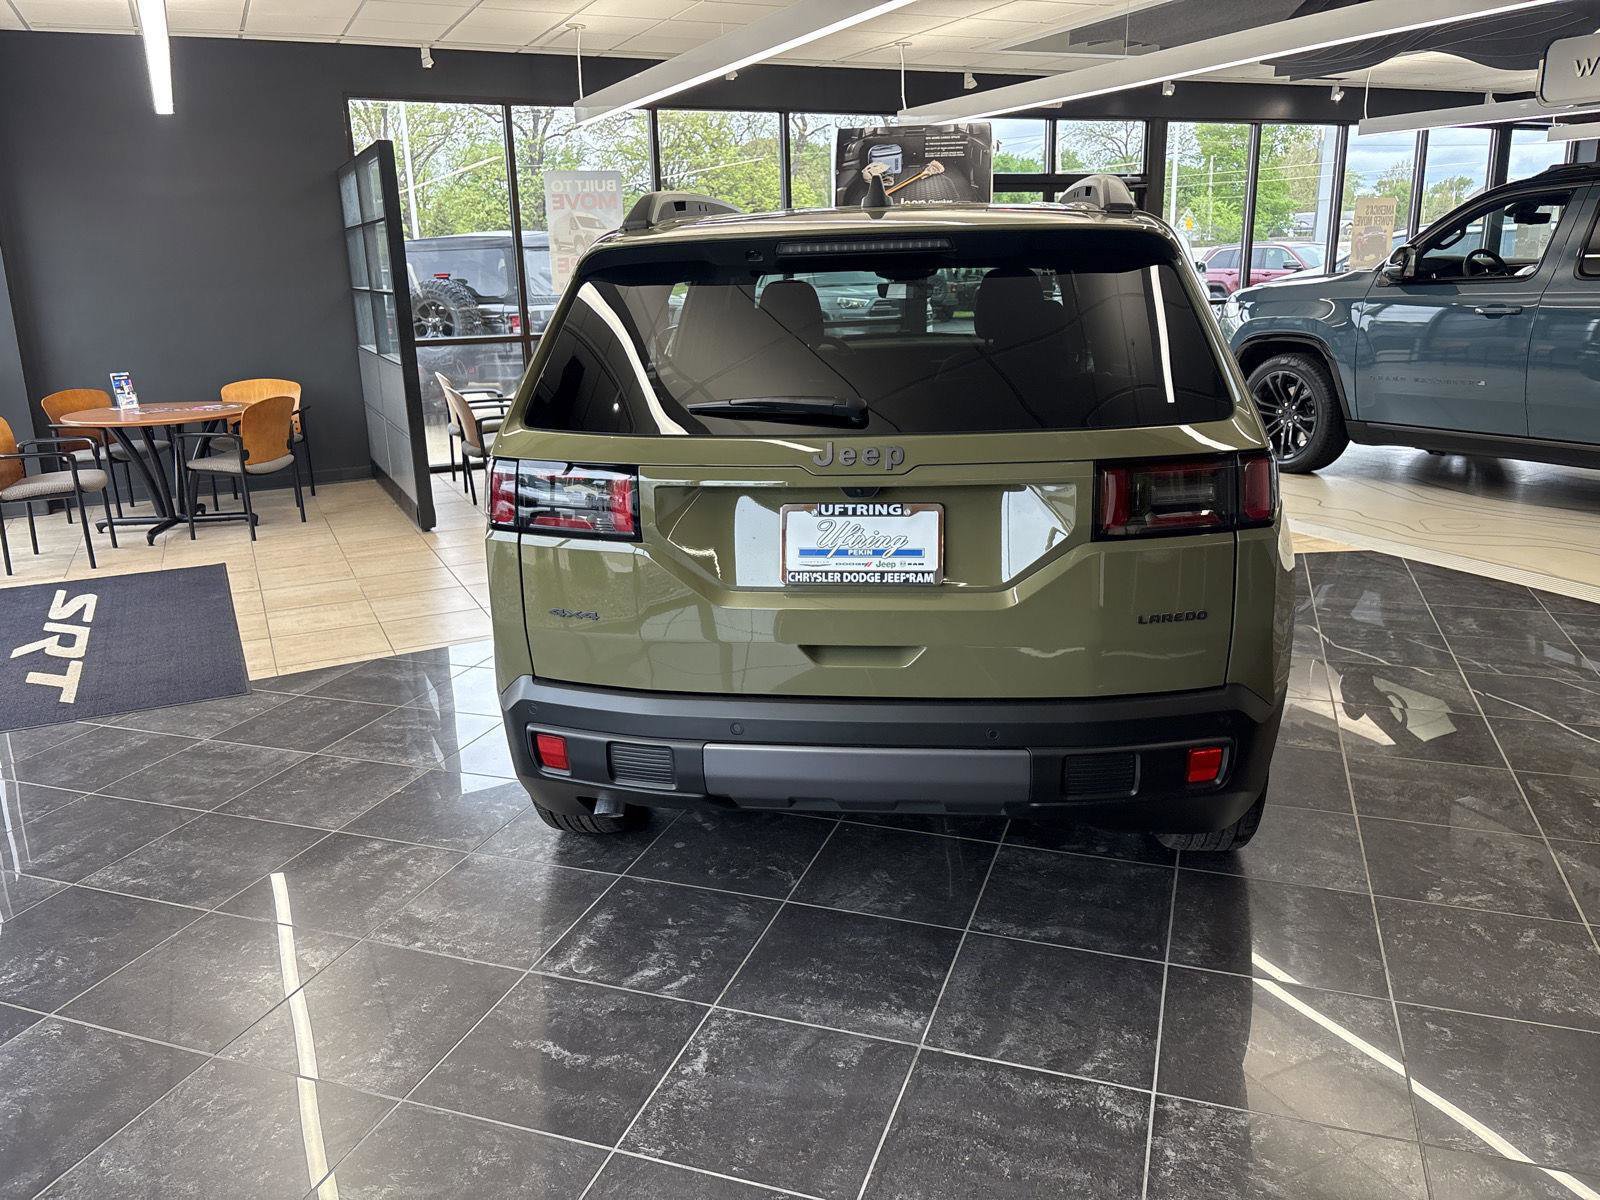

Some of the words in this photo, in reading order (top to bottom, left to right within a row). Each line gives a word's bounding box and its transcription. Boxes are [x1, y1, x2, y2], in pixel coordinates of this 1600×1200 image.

[813, 441, 905, 471] Jeep
[820, 503, 903, 516] UFTRING
[816, 518, 909, 560] Uftring
[847, 549, 874, 557] PEKIN
[875, 560, 897, 569] Jeep
[788, 572, 841, 583] CHRYSLER
[842, 572, 881, 583] DODGE
[909, 572, 934, 583] RAM
[1137, 609, 1208, 625] LAREDO
[9, 589, 98, 704] SRT
